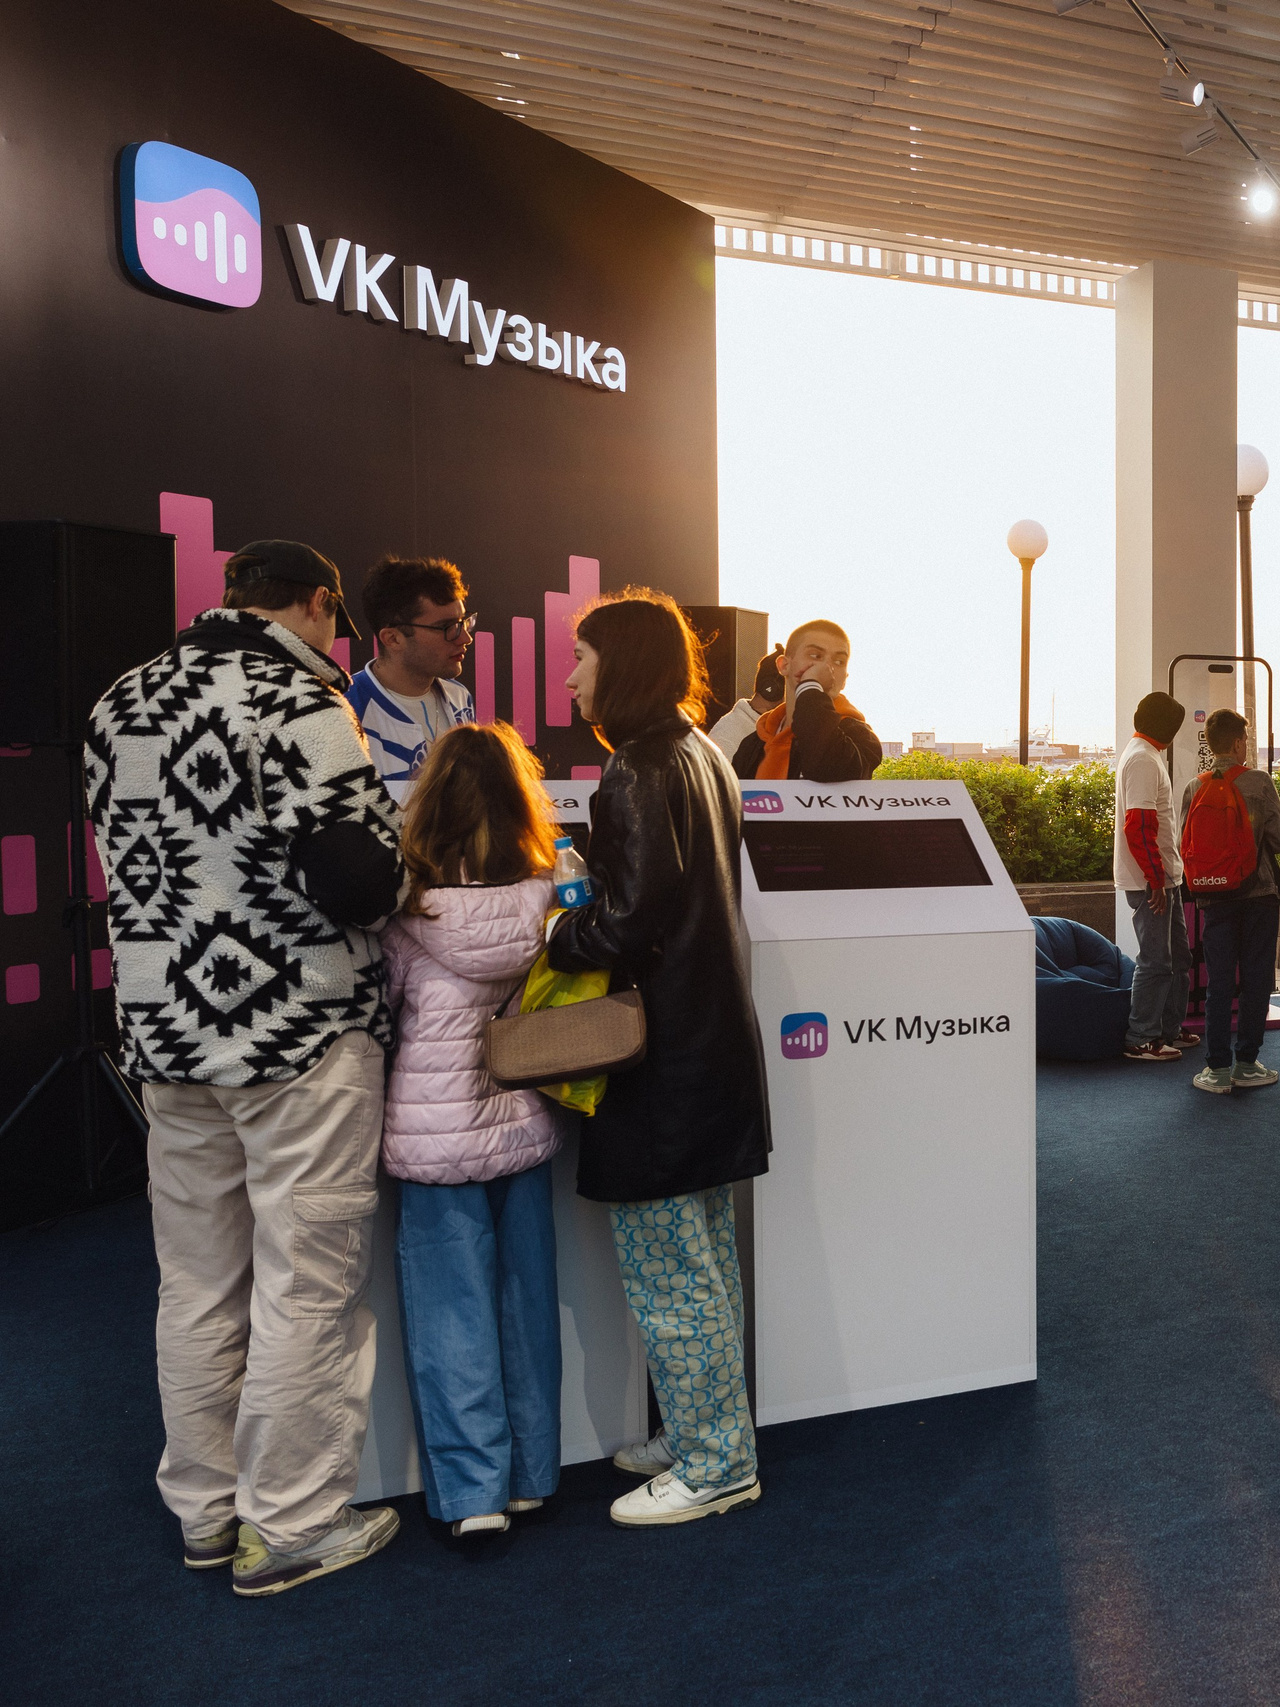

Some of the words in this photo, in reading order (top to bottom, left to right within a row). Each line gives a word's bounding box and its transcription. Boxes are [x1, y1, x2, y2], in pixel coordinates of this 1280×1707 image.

[286, 222, 399, 323] VK
[406, 264, 626, 393] Музыка
[794, 795, 837, 808] VK
[842, 795, 951, 811] Музыка
[1192, 875, 1228, 886] adidas
[843, 1018, 887, 1044] VK
[895, 1014, 1010, 1045] Музыка
